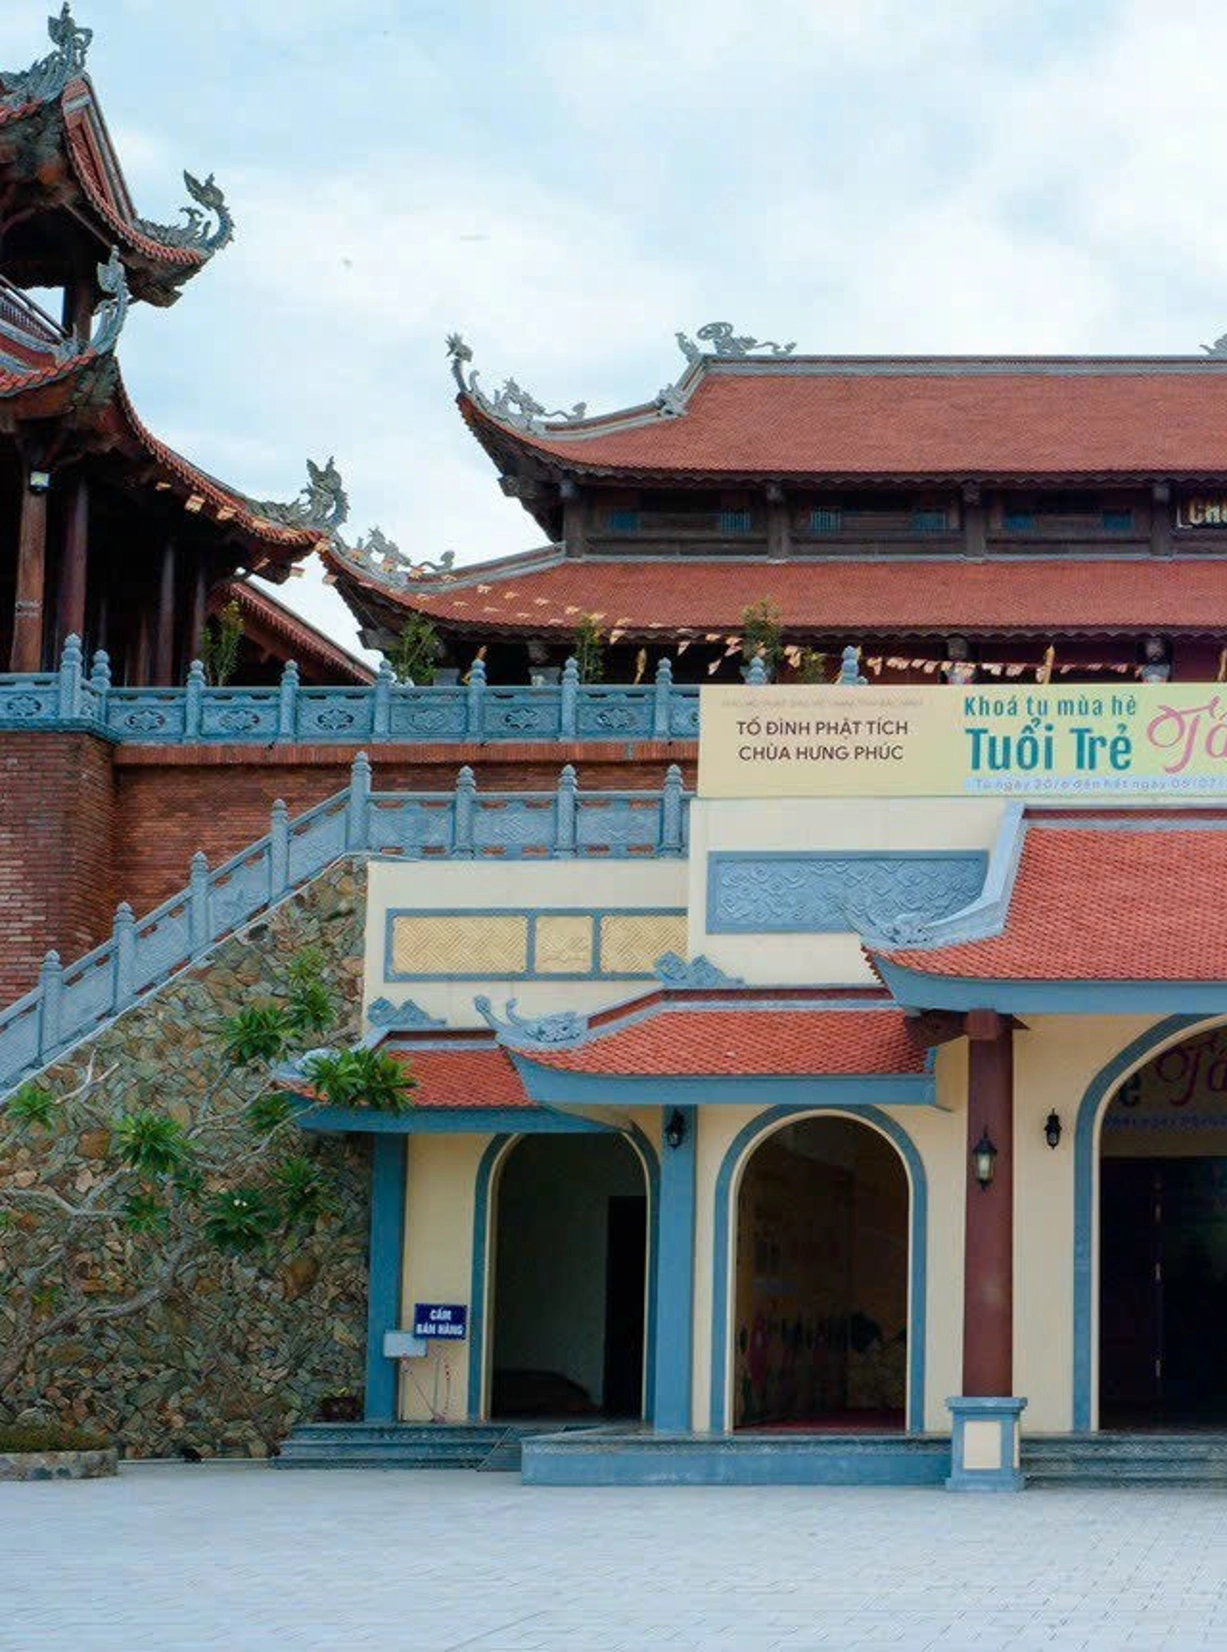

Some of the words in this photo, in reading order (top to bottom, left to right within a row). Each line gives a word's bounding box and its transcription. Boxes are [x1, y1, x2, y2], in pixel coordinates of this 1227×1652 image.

[1057, 694, 1104, 716] mùa
[1111, 694, 1136, 716] hè
[765, 717, 811, 736] ĐÌNH
[815, 717, 863, 740] PHẬT
[865, 716, 909, 736] TÍCH
[738, 741, 791, 761] CHÙA
[795, 745, 850, 761] HƯNG
[854, 743, 904, 761] PHÚC
[965, 716, 1054, 771] Tuổi
[1069, 723, 1133, 771] Trẻ
